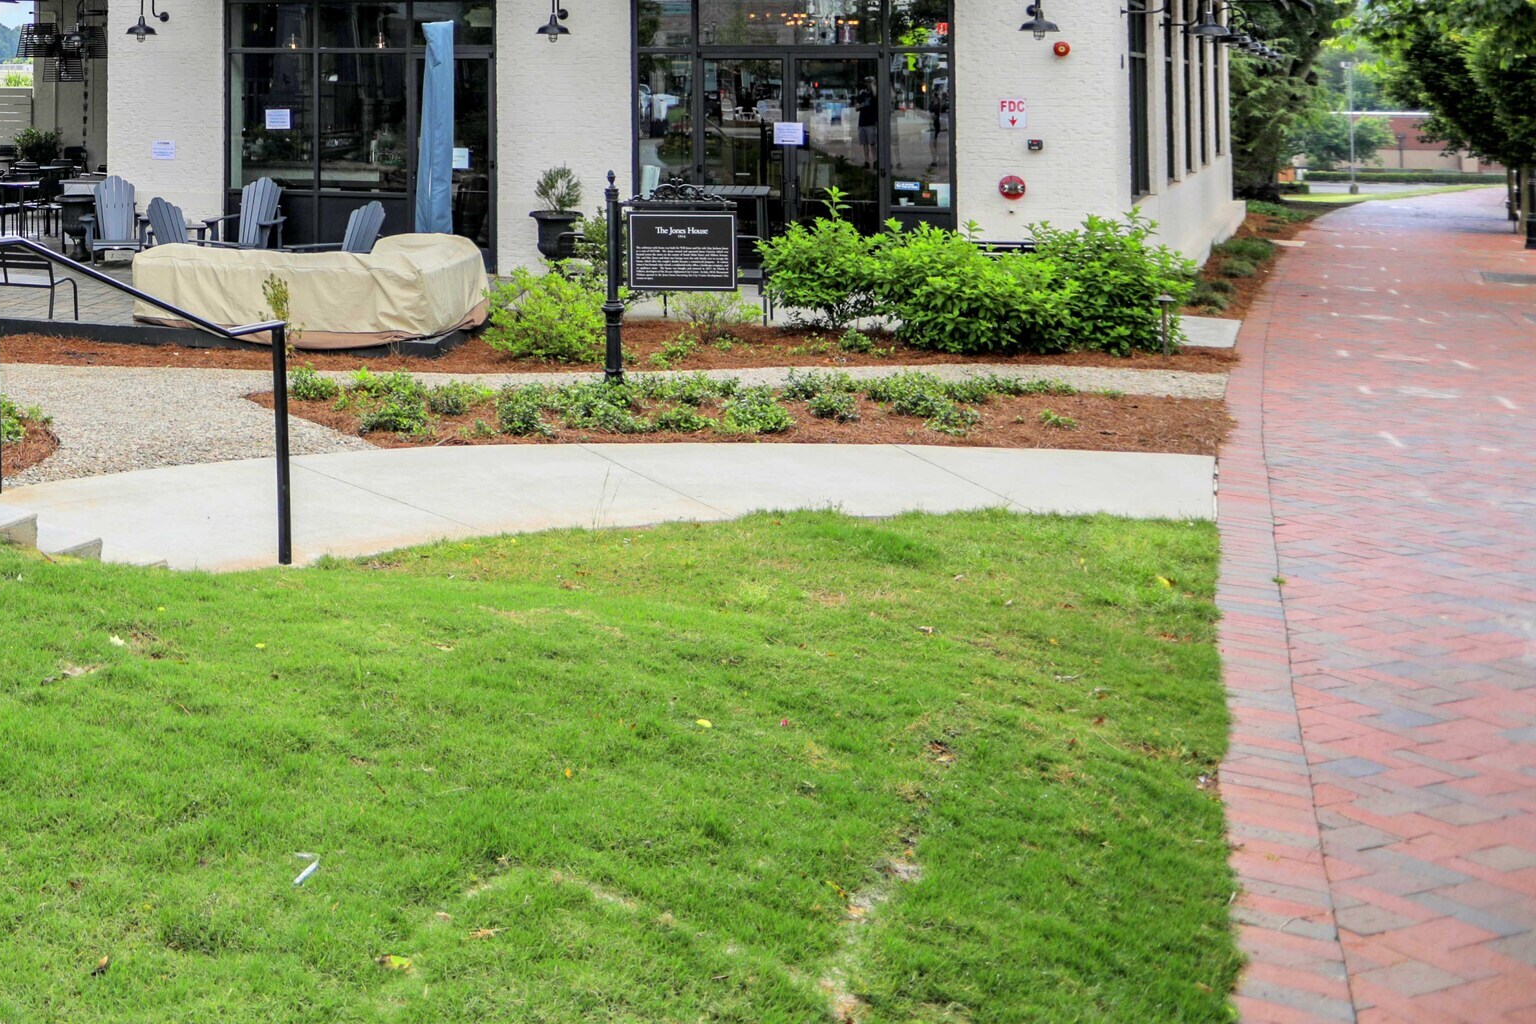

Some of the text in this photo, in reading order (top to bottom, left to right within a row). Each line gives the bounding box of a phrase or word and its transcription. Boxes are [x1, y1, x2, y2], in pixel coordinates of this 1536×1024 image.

[1000, 101, 1025, 112] FDC
[655, 226, 708, 236] The Jones House
